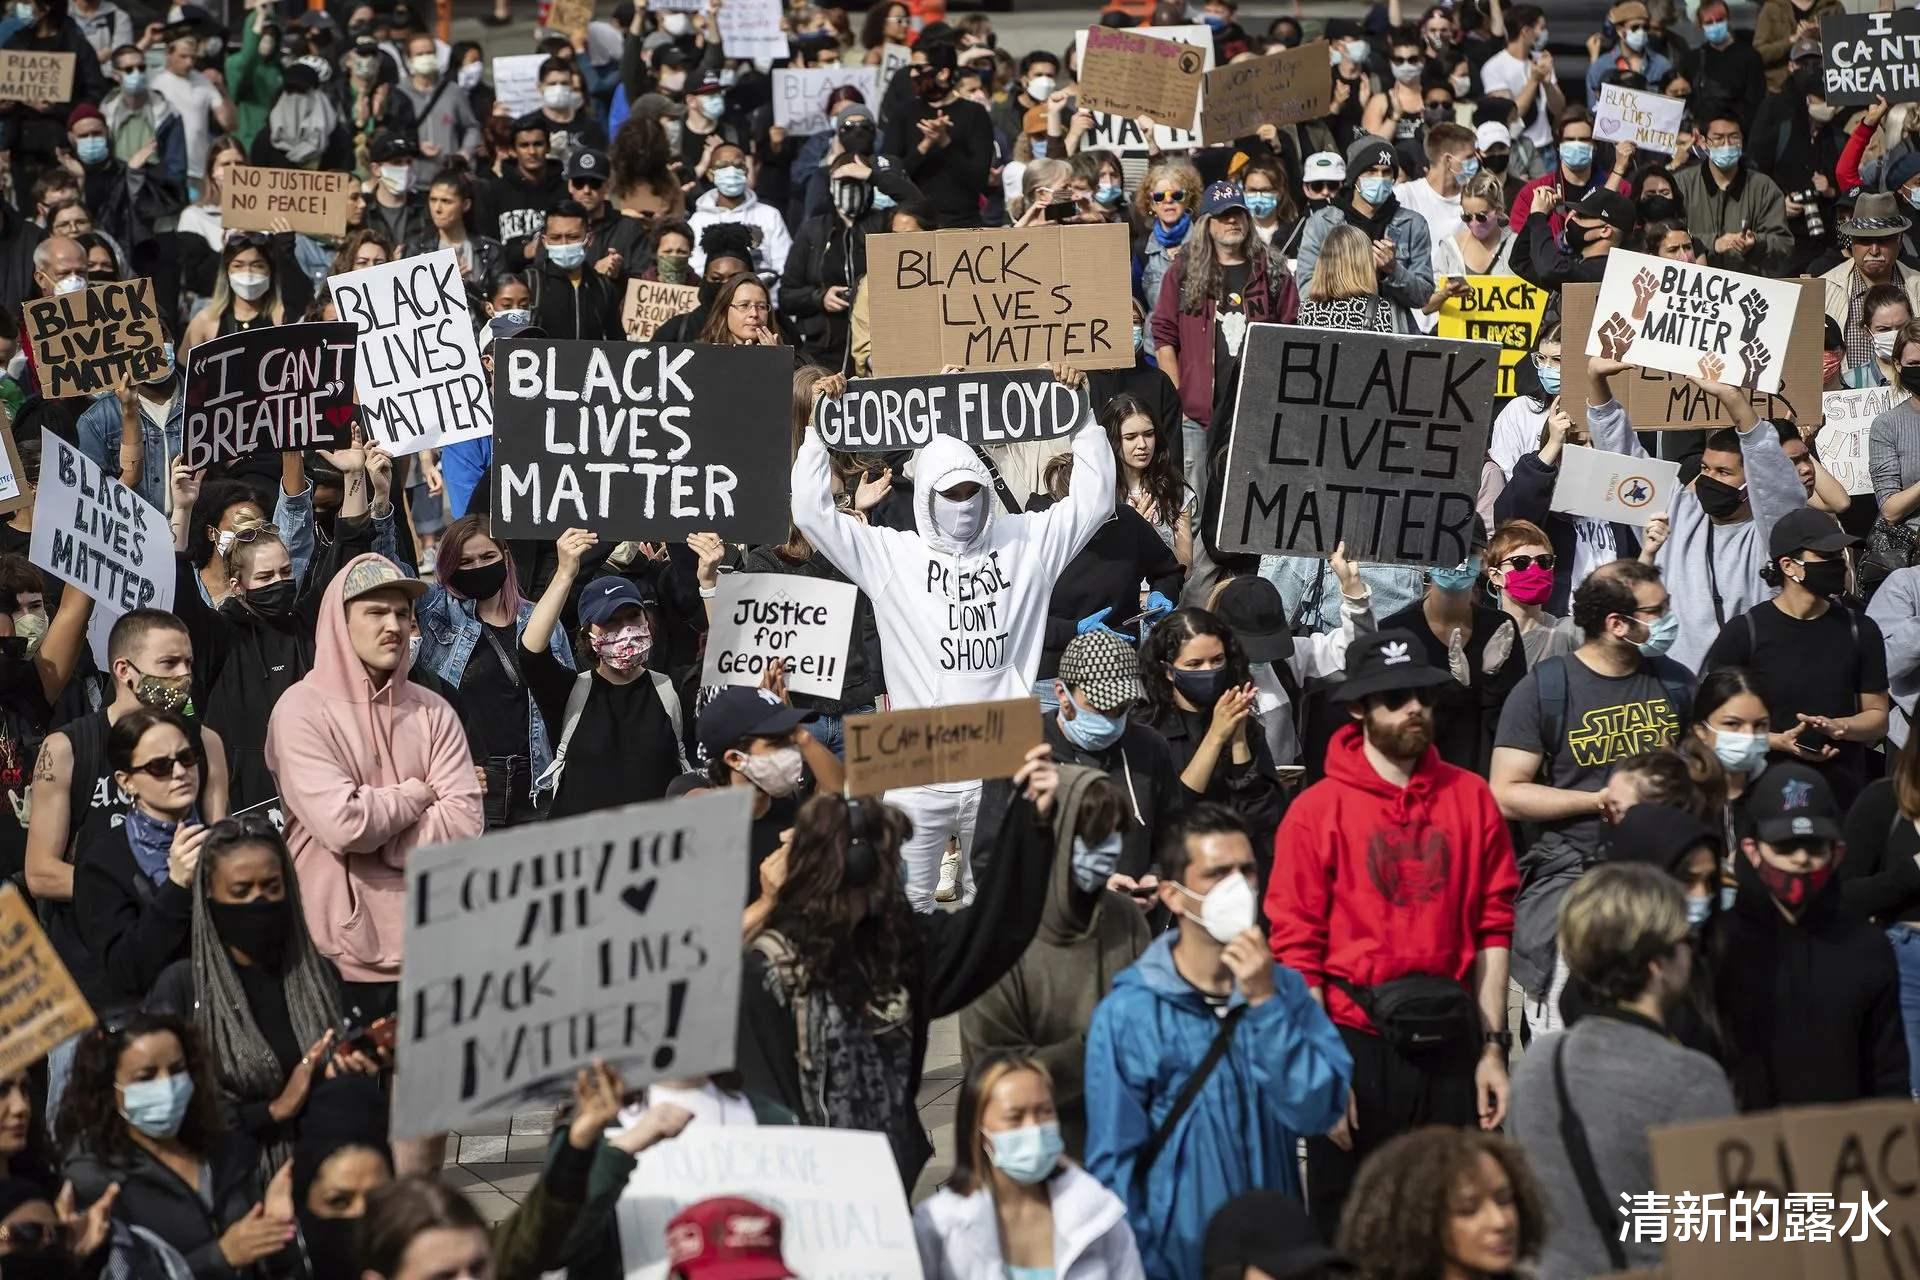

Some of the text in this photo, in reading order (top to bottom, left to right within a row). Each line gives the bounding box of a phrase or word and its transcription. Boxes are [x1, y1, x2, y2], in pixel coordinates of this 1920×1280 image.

[1867, 12, 1892, 36] I
[7, 70, 59, 84] LIVES
[8, 55, 61, 70] BLACK
[1826, 62, 1920, 93] BREATH
[0, 83, 60, 99] MATTER
[784, 74, 871, 100] BLAK
[1606, 89, 1638, 110] BLACK
[1622, 110, 1653, 128] LIVES
[1635, 127, 1675, 148] MATTER
[231, 169, 341, 192] NO JUSTICE!
[231, 194, 327, 215] NO PEACE!
[897, 242, 1041, 289] BLACK
[1660, 266, 1741, 305] BLACK
[30, 278, 156, 340] BLACK
[335, 263, 466, 334] BLACK
[637, 284, 695, 310] CHANGE
[943, 285, 1073, 325] LIVES
[1460, 283, 1537, 312] BLACK
[1667, 296, 1720, 319] LIVES
[41, 320, 153, 364] LIVES
[362, 318, 466, 388] LIVES
[966, 319, 1111, 365] MATTER
[1472, 323, 1526, 347] LIVES
[1641, 311, 1733, 354] MATTER
[51, 346, 168, 397] MATTER
[258, 338, 356, 393] CAN'T
[508, 346, 694, 403] BLACK
[1278, 341, 1486, 422] BLACK
[362, 374, 492, 442] MATTER
[820, 381, 1079, 445] GEORGE FLOYD
[1824, 390, 1891, 421] STAN
[545, 405, 692, 462] LIVES
[1269, 412, 1461, 479] LIVES
[58, 443, 148, 532] BLACK
[501, 463, 738, 525] MATTER
[74, 498, 147, 568] LIVES
[1240, 481, 1476, 567] MATTER
[51, 528, 155, 612] MATTER
[927, 551, 1011, 602] PLEASE
[734, 598, 827, 626] Justice
[949, 601, 997, 631] DON'T
[755, 626, 797, 649] for
[940, 632, 1009, 671] SHOOT
[717, 650, 836, 682] George!!
[1569, 698, 1678, 741] STAR
[852, 724, 871, 763] I
[628, 828, 700, 872] FOR
[516, 885, 607, 949] ALL
[413, 925, 708, 1043] BLACK LIVES
[1716, 1124, 1920, 1230] BLAC
